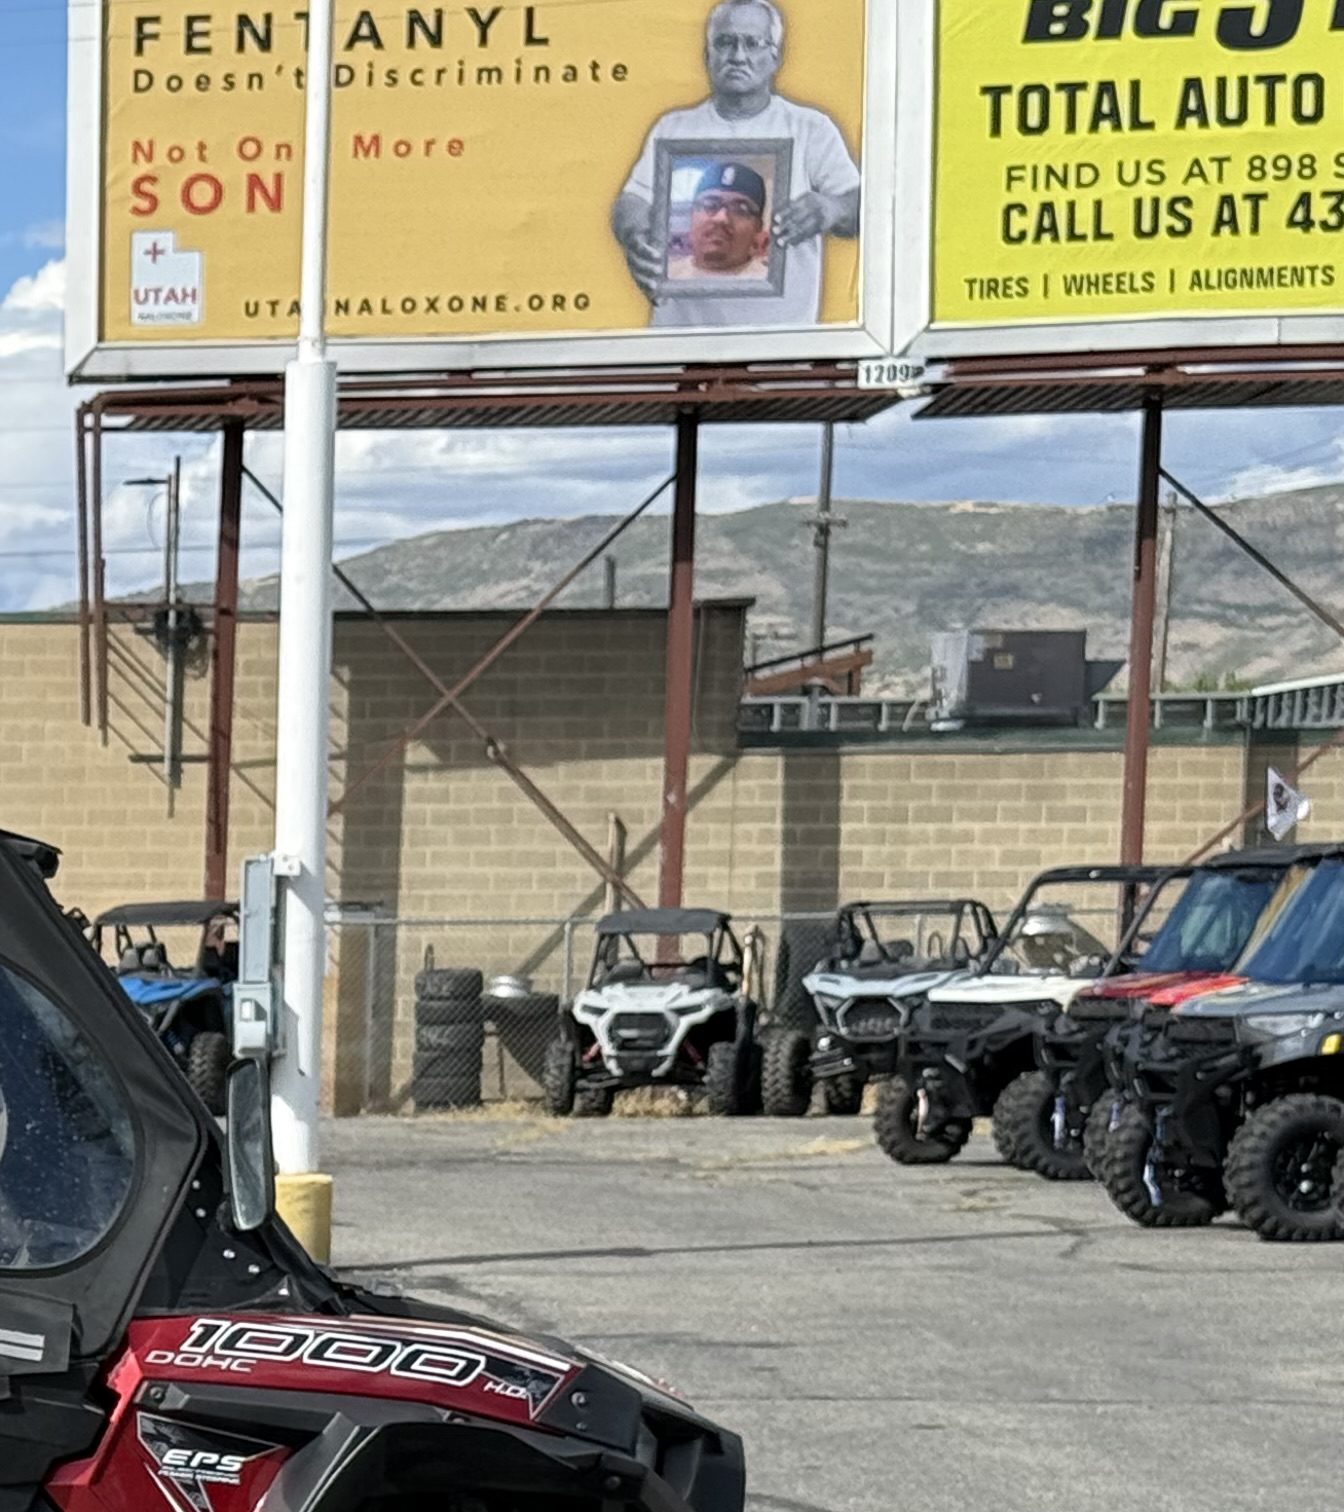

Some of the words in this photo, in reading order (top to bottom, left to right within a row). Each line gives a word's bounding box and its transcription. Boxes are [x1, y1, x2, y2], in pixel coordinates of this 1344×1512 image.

[133, 64, 304, 94] Doesn't
[333, 59, 629, 88] Discriminate
[980, 79, 1155, 138] TOTAL
[1174, 72, 1325, 131] AUTO
[131, 139, 208, 164] Not
[236, 136, 294, 162] On
[352, 134, 466, 159] More
[1005, 162, 1100, 192] FIND
[1117, 159, 1166, 187] US
[1182, 156, 1231, 185] AT
[1247, 153, 1317, 182] 898
[130, 172, 284, 217] SON
[1001, 197, 1114, 245] CALL
[1133, 195, 1193, 240] US
[1212, 192, 1268, 237] AT
[134, 287, 197, 305] UTAH
[963, 276, 1029, 300] TIRES
[1062, 271, 1155, 296] WHEELS
[1189, 264, 1335, 291] ALIGNMENTS
[244, 292, 591, 318] UTANALOXONE.ORG
[144, 1349, 257, 1373] DOHC
[179, 1318, 487, 1388] 1000
[161, 1448, 248, 1472] EPS
